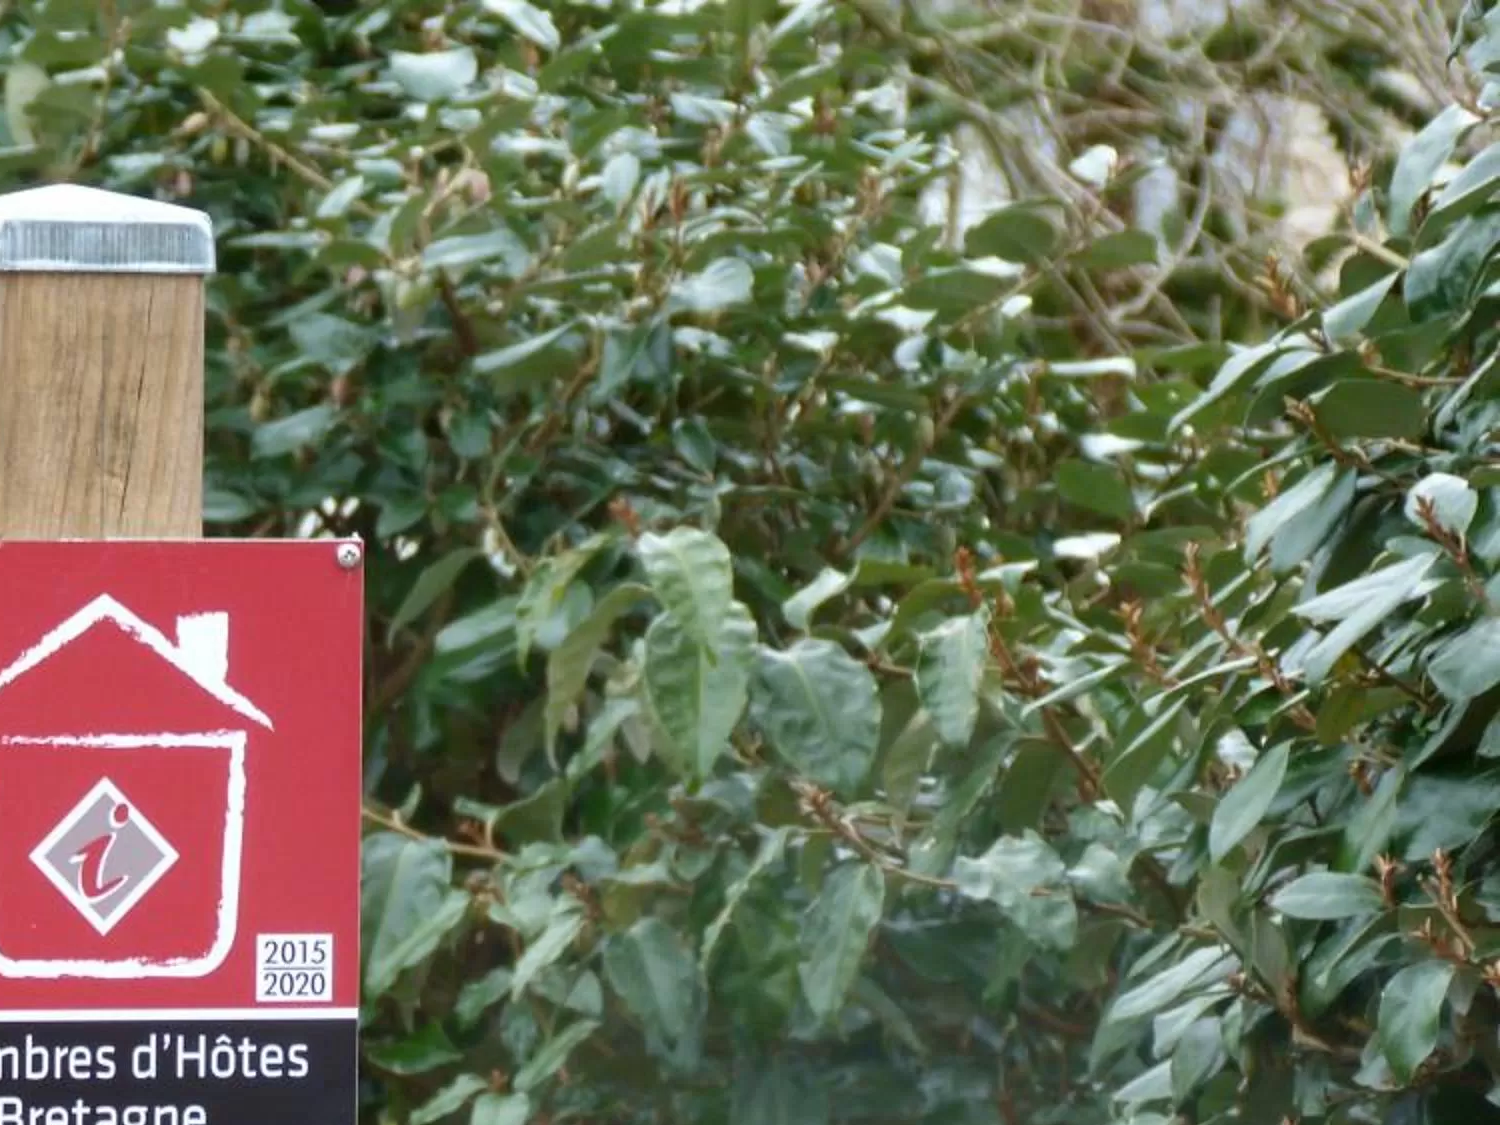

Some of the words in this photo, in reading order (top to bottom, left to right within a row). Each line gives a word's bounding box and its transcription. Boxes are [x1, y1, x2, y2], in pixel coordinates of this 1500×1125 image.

[263, 939, 327, 965] 2015
[263, 971, 327, 997] 2020
[131, 1033, 310, 1080] d'Hôtes
